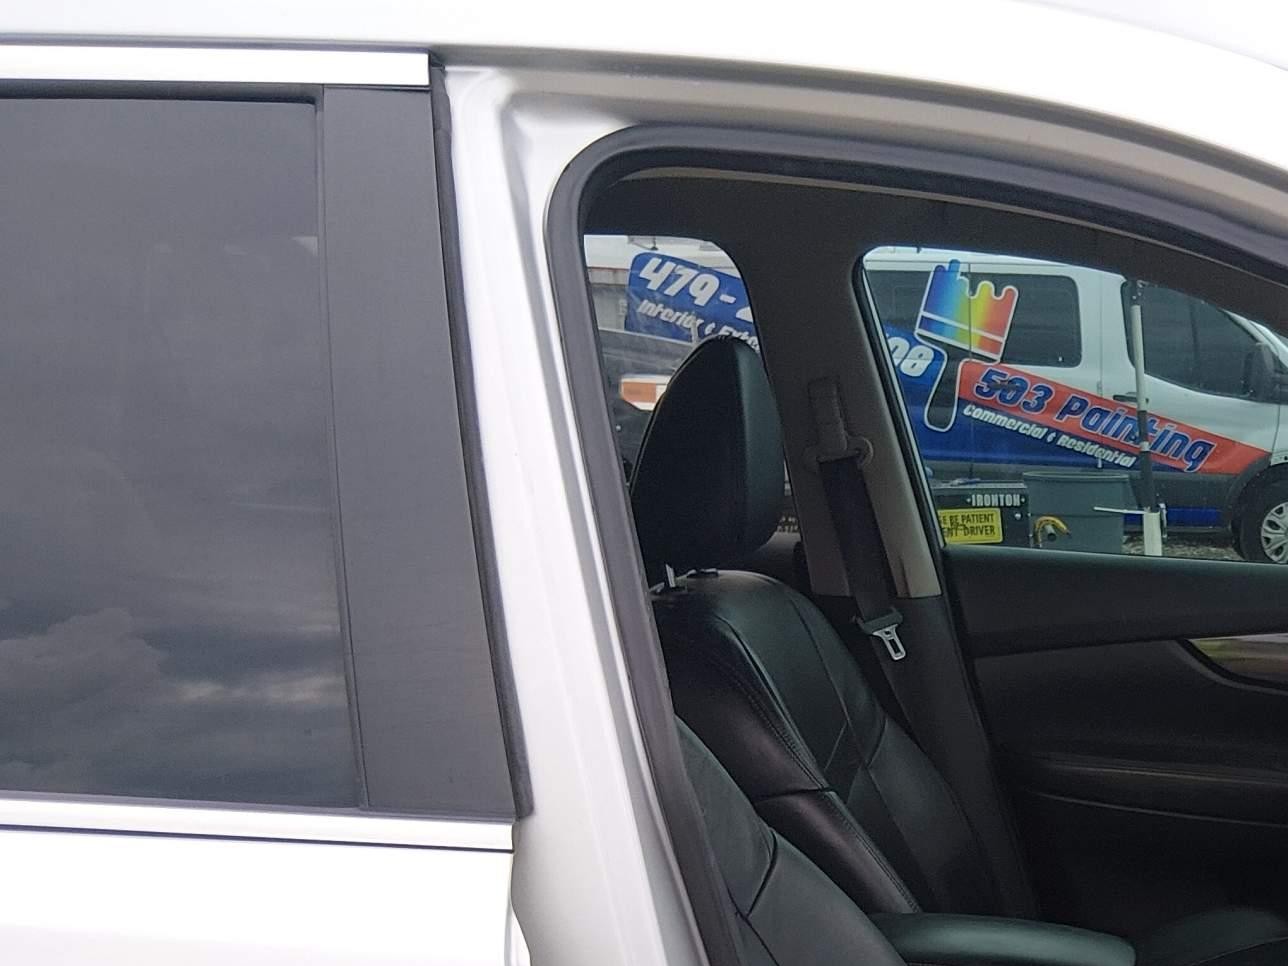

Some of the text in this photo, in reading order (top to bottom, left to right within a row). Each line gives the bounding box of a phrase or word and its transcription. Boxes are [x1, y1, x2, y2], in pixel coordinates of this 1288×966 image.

[639, 257, 753, 323] 479-
[1056, 434, 1136, 468] Residential
[961, 513, 995, 524] PATIENT
[963, 525, 996, 537] DRIVER
